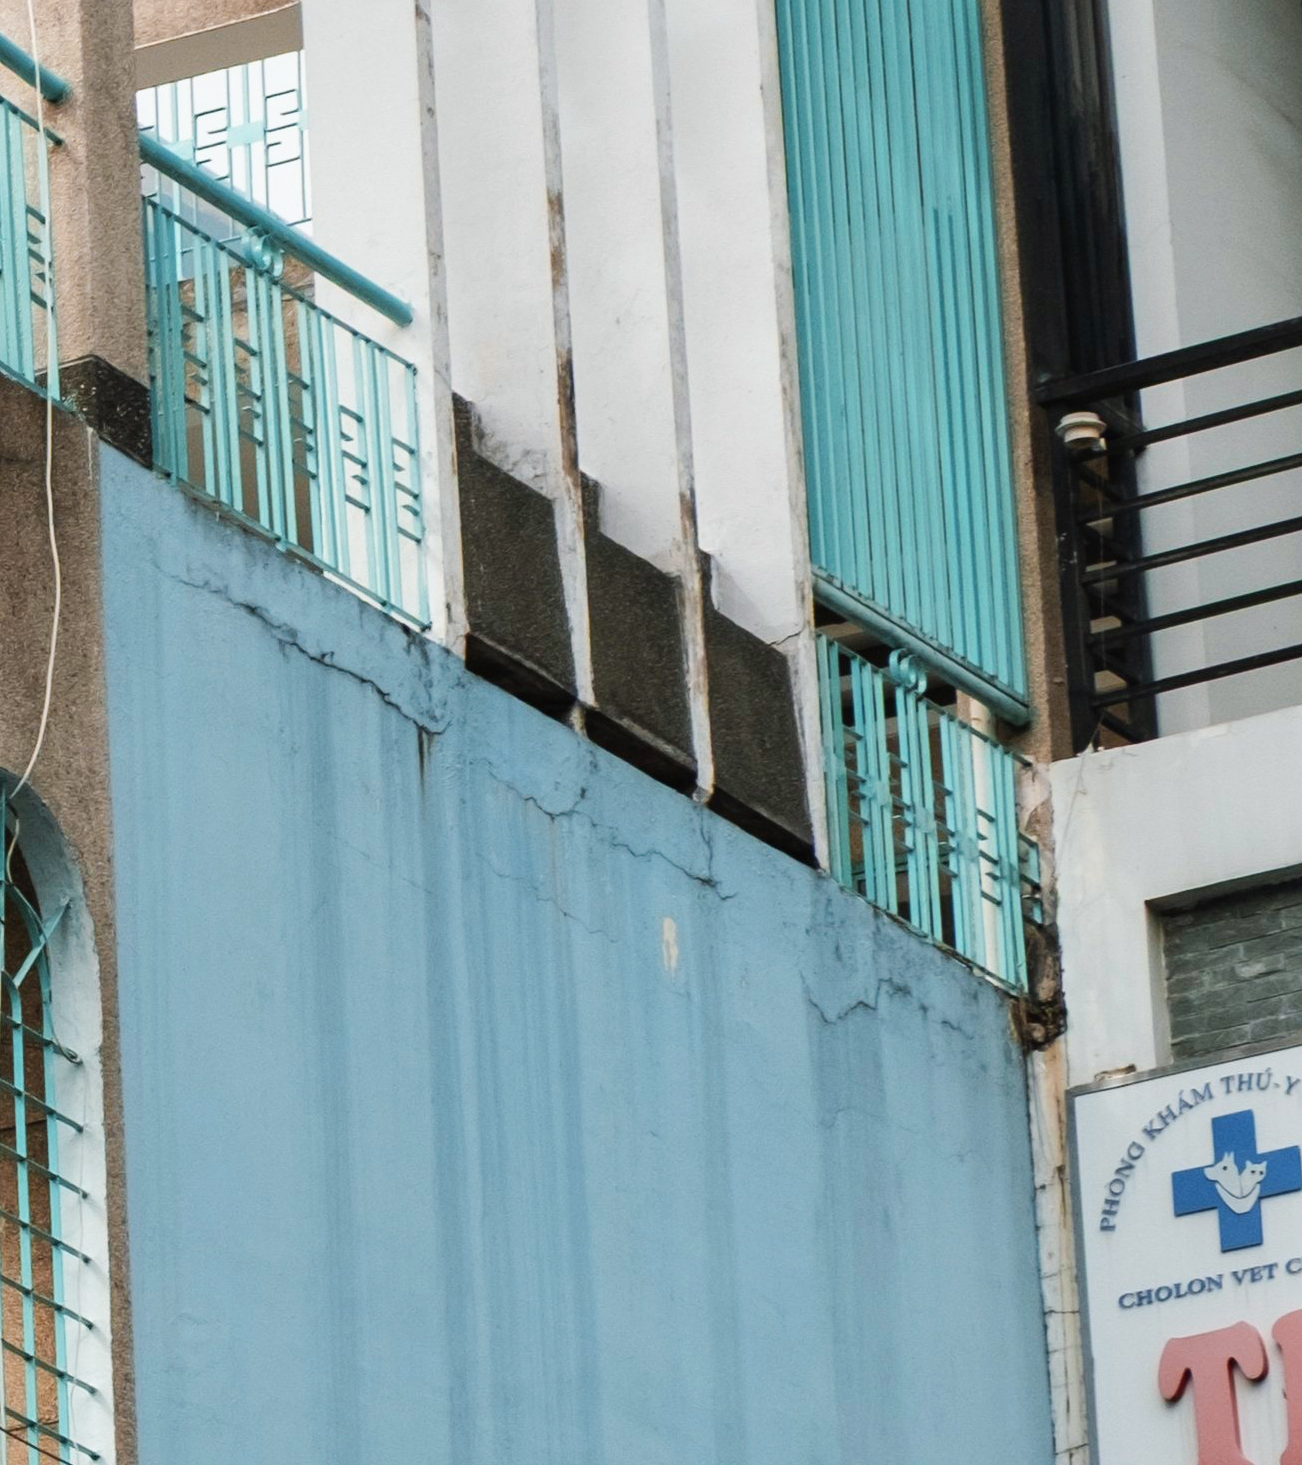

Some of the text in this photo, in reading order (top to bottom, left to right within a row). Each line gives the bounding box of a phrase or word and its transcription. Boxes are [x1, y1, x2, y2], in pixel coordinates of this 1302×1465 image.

[1141, 1081, 1215, 1141] KHÁM
[1117, 1273, 1223, 1311] CHOLON
[1231, 1262, 1279, 1287] VET
